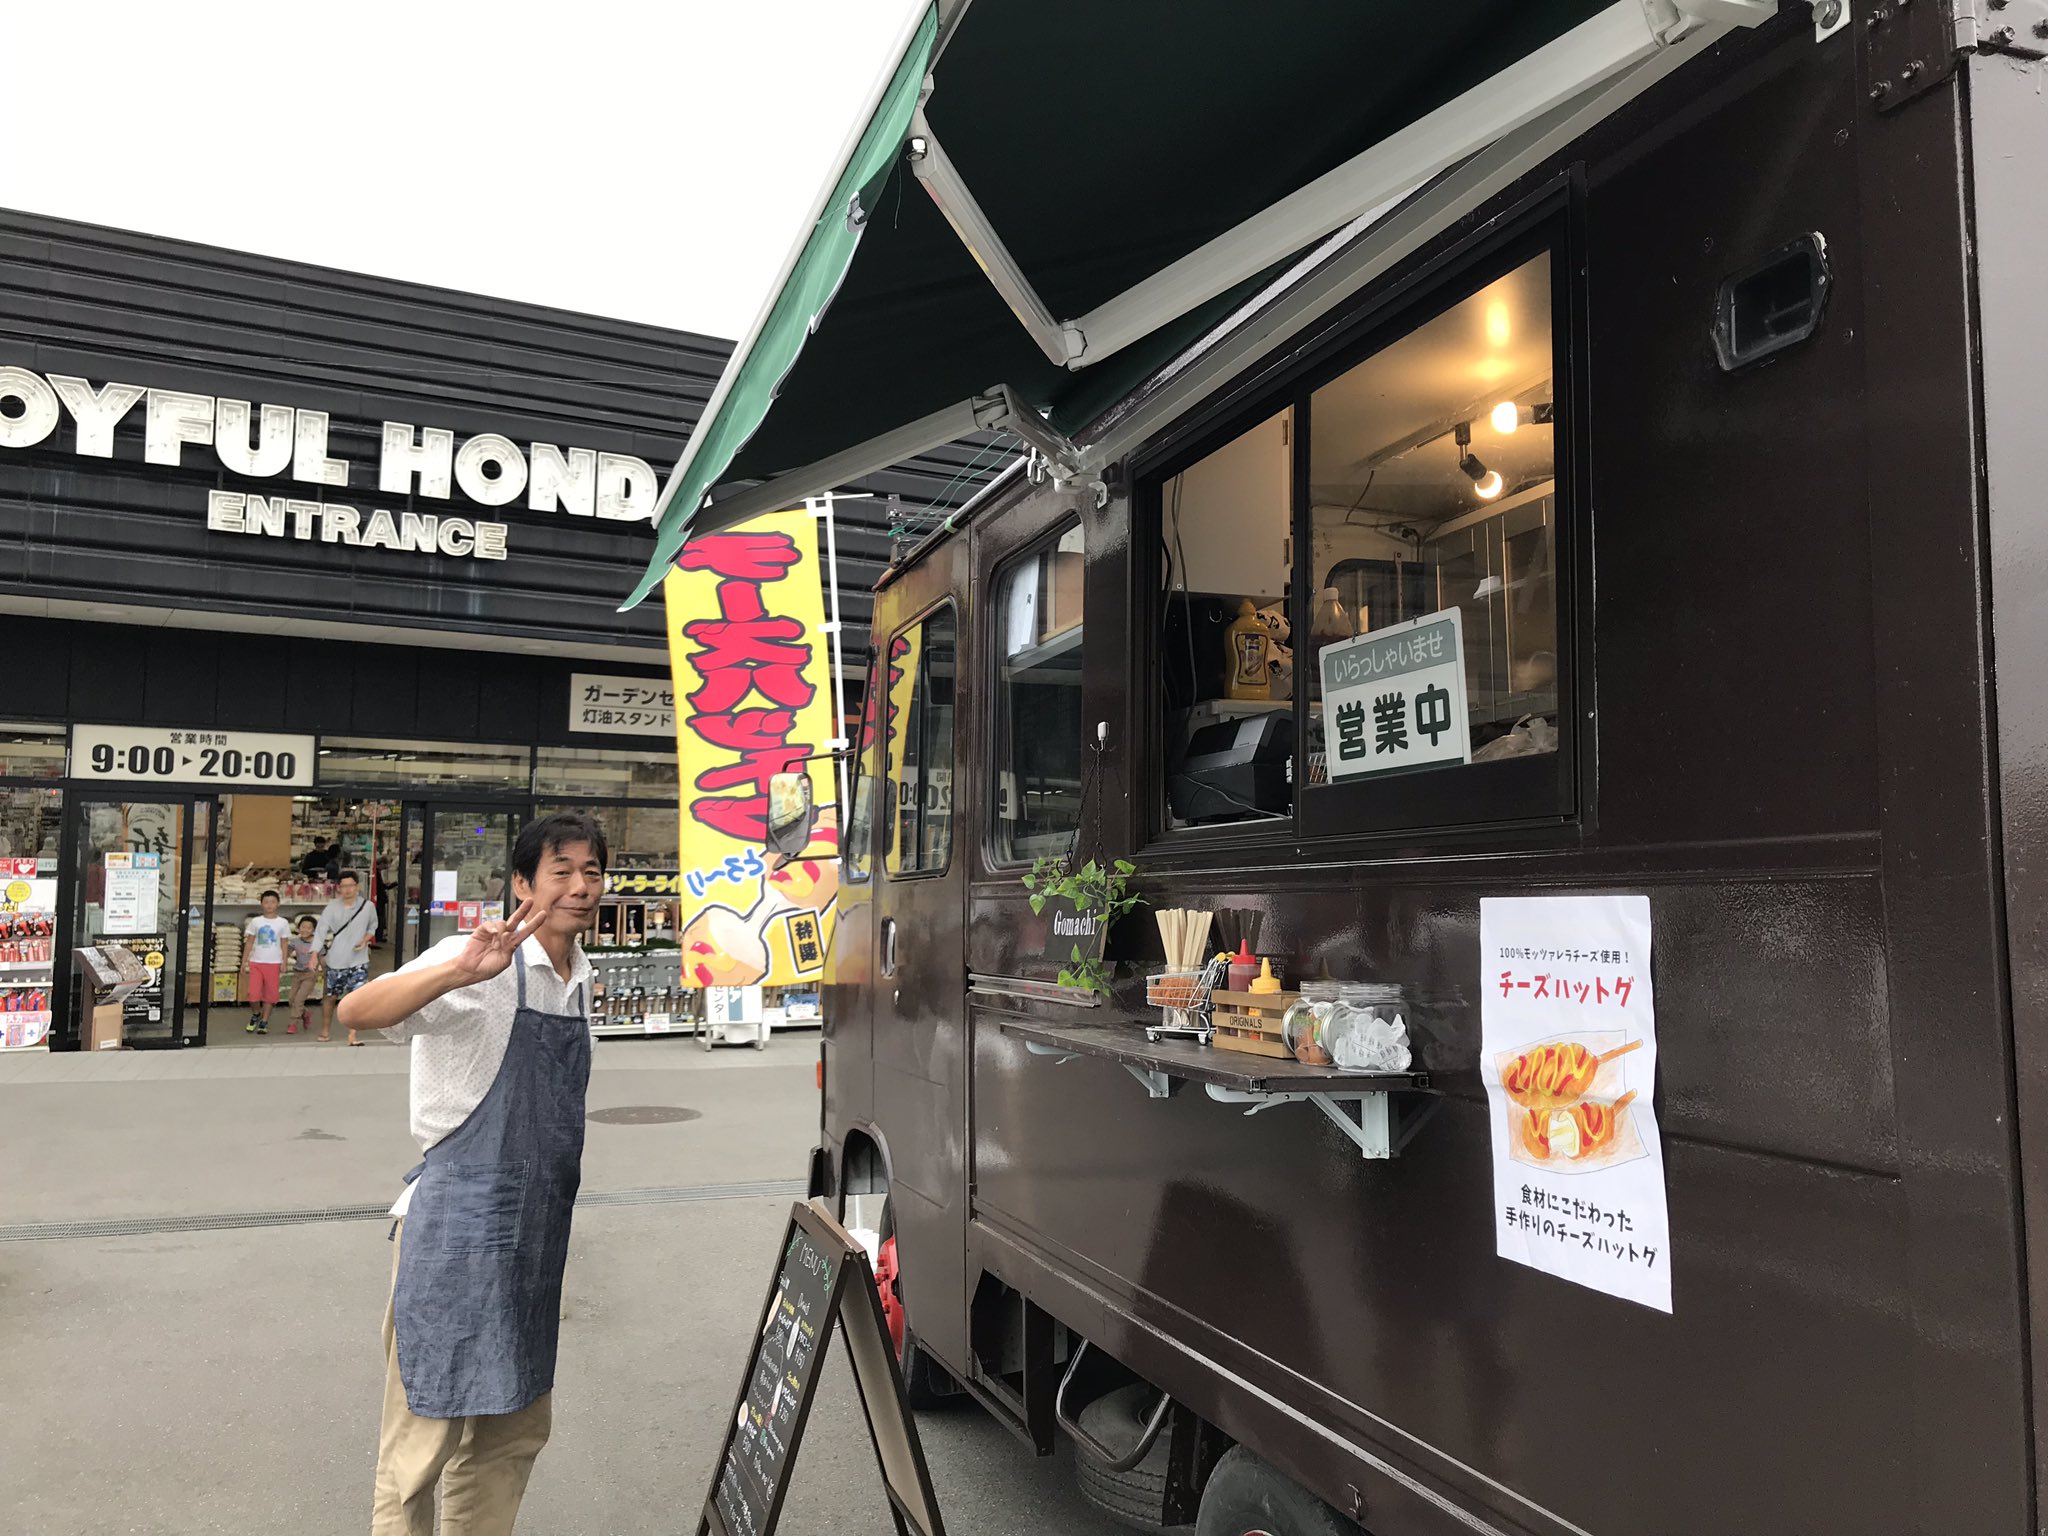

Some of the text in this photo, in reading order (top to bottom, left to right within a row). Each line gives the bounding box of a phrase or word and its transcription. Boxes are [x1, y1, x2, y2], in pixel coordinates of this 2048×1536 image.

[207, 488, 508, 561] ENTRANCE
[1334, 629, 1444, 683] いらっしゃいませ
[582, 708, 672, 727] 灯油スタンド
[1335, 683, 1452, 762] 営業中
[169, 732, 228, 746] 営業時間
[91, 743, 296, 780] 9:00 20:00
[1053, 908, 1097, 936] Gomachi
[1499, 970, 1635, 1009] チーズハットグ
[1229, 1015, 1263, 1029] ORIGINALS
[1521, 1183, 1634, 1233] 食材にこだわった
[1505, 1206, 1659, 1269] 手作りのチーズハットグ
[799, 1242, 822, 1276] MENU
